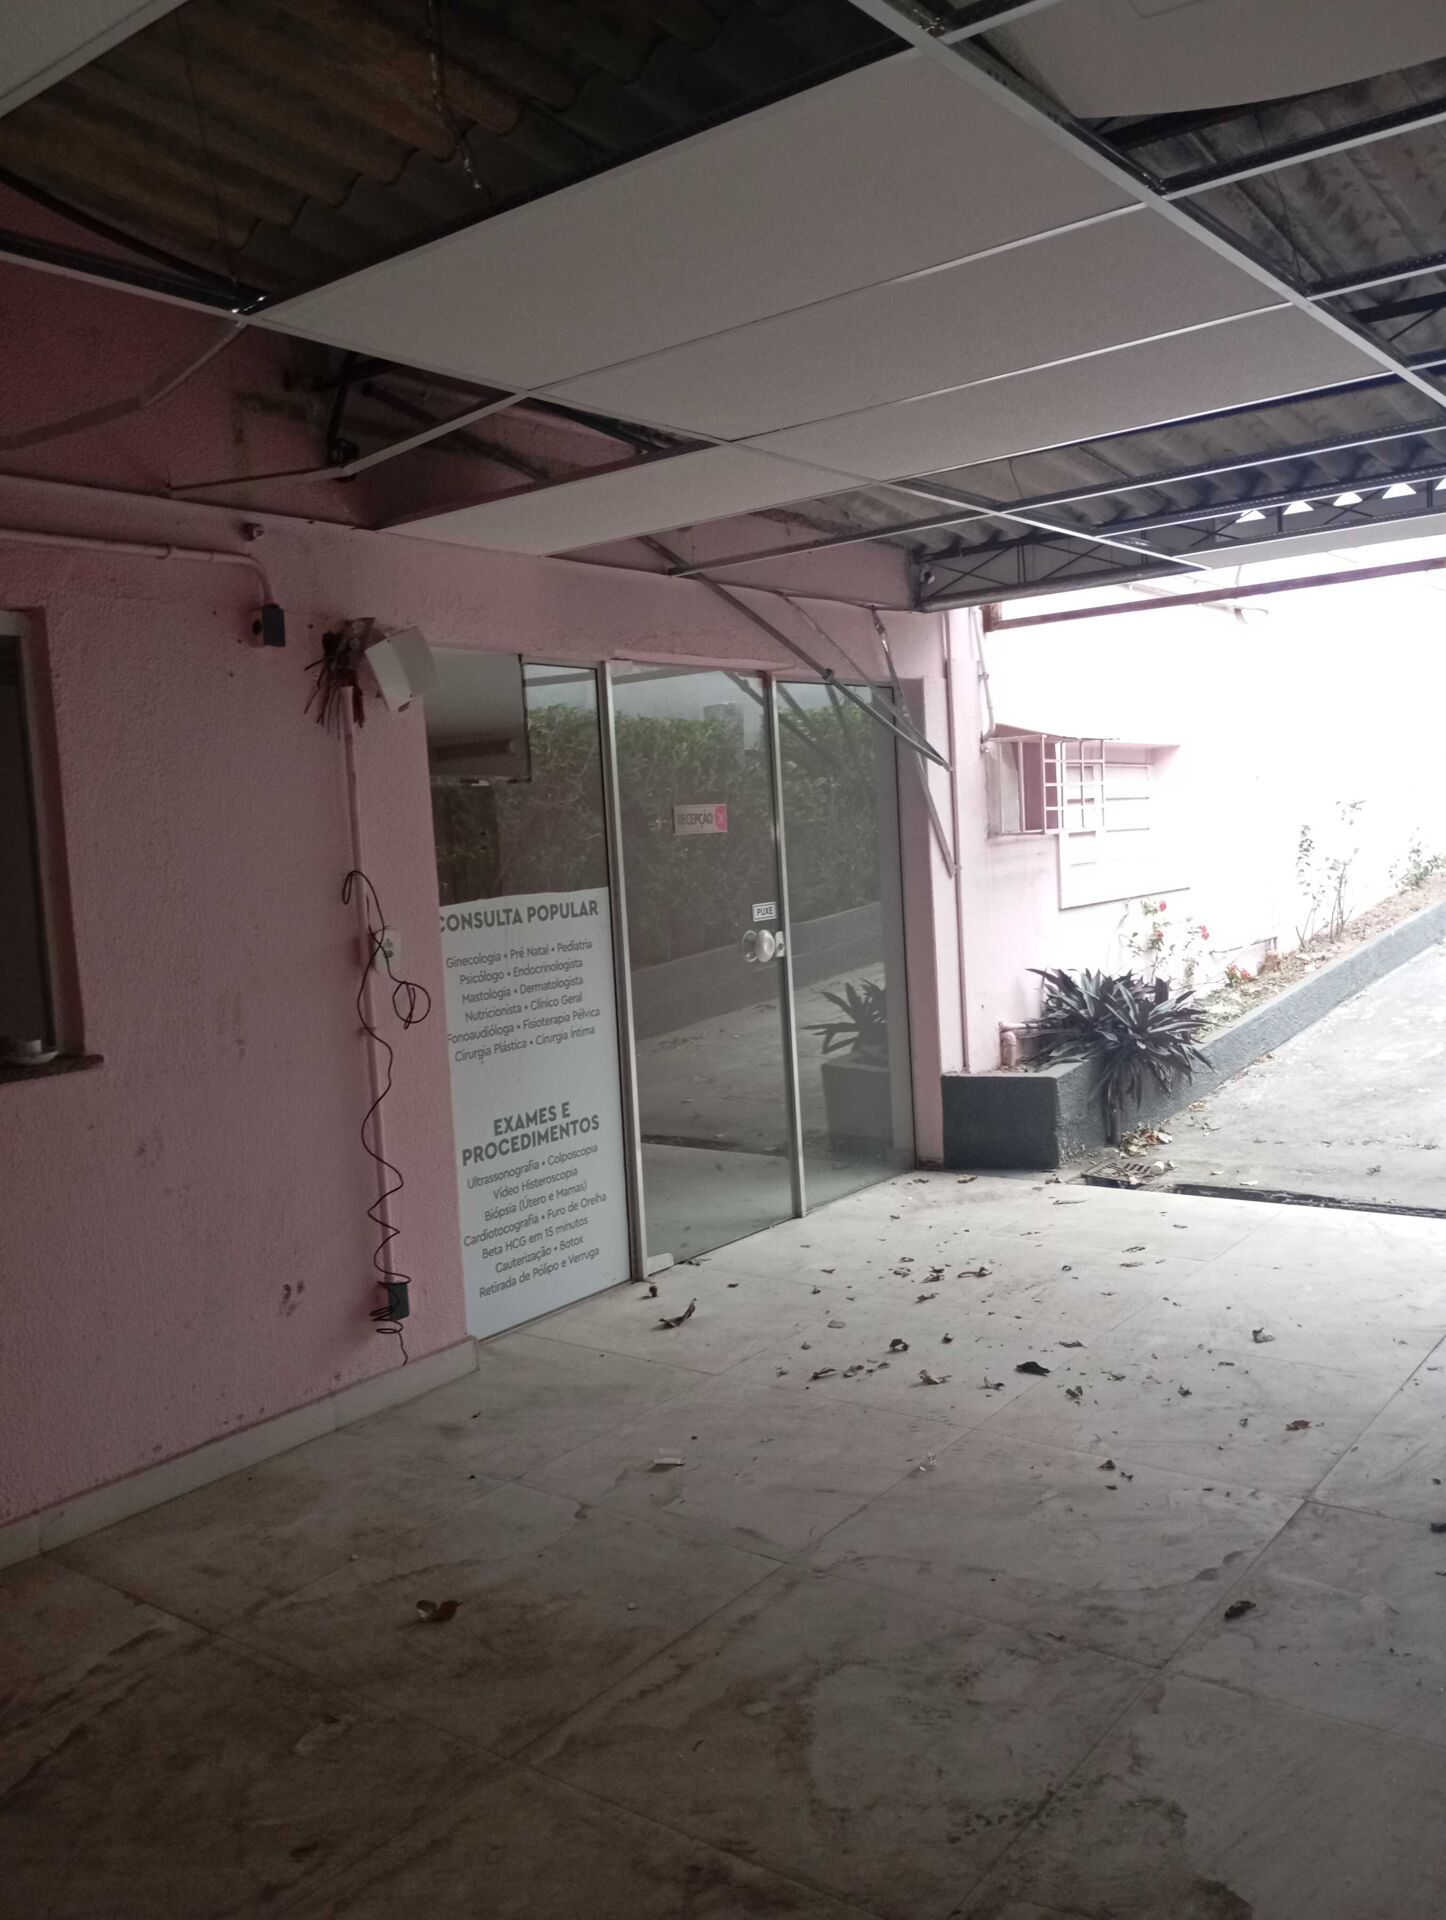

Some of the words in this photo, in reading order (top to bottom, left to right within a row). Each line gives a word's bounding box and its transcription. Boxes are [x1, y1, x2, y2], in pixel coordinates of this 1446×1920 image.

[527, 900, 599, 923] POPULAR
[756, 906, 774, 916] PUXE
[446, 951, 501, 969] Ginecologia
[510, 946, 525, 960] Pré
[527, 944, 549, 957] Natal
[557, 938, 593, 953] Pediatria
[460, 967, 504, 986] Psicólogo
[513, 958, 583, 977] Endocrinologista
[462, 985, 511, 1004] Mastologia
[520, 975, 584, 995] Dermatologista
[465, 1003, 522, 1023] Nutricionista
[530, 998, 559, 1012] Clínico
[561, 992, 583, 1007] Geral
[523, 1013, 571, 1030] Fisioterapia
[572, 1008, 600, 1023] Pélvica
[454, 1045, 492, 1063] Cirurgia
[494, 1037, 528, 1055] Plástica
[535, 1030, 569, 1046] Cirurgia
[493, 1105, 557, 1137] EXAMES
[561, 1101, 571, 1119] E
[462, 1114, 600, 1167] PROCEDIMENTOS
[467, 1160, 540, 1190] Ultrassonografia
[547, 1143, 598, 1167] Colposcopia
[521, 1167, 578, 1193] Histeroscopia
[484, 1202, 518, 1222] Biópsia
[519, 1194, 547, 1212] (Útero
[548, 1193, 554, 1201] e
[556, 1180, 587, 1199] Mamas)
[463, 1214, 539, 1247] Cardiotocografia
[547, 1205, 566, 1220] Furo
[567, 1200, 579, 1212] de
[580, 1192, 607, 1209] Orelha
[482, 1244, 503, 1260] Beta
[505, 1236, 527, 1252] HCG
[528, 1232, 543, 1243] em
[545, 1227, 554, 1238] 15
[555, 1216, 589, 1235] minutos
[495, 1245, 552, 1274] Cauterização
[559, 1234, 584, 1251] Botox
[479, 1273, 517, 1299] Retirada
[518, 1270, 531, 1284] de
[532, 1261, 559, 1279] Pólipo
[561, 1259, 567, 1268] e
[568, 1246, 600, 1267] Verruga
